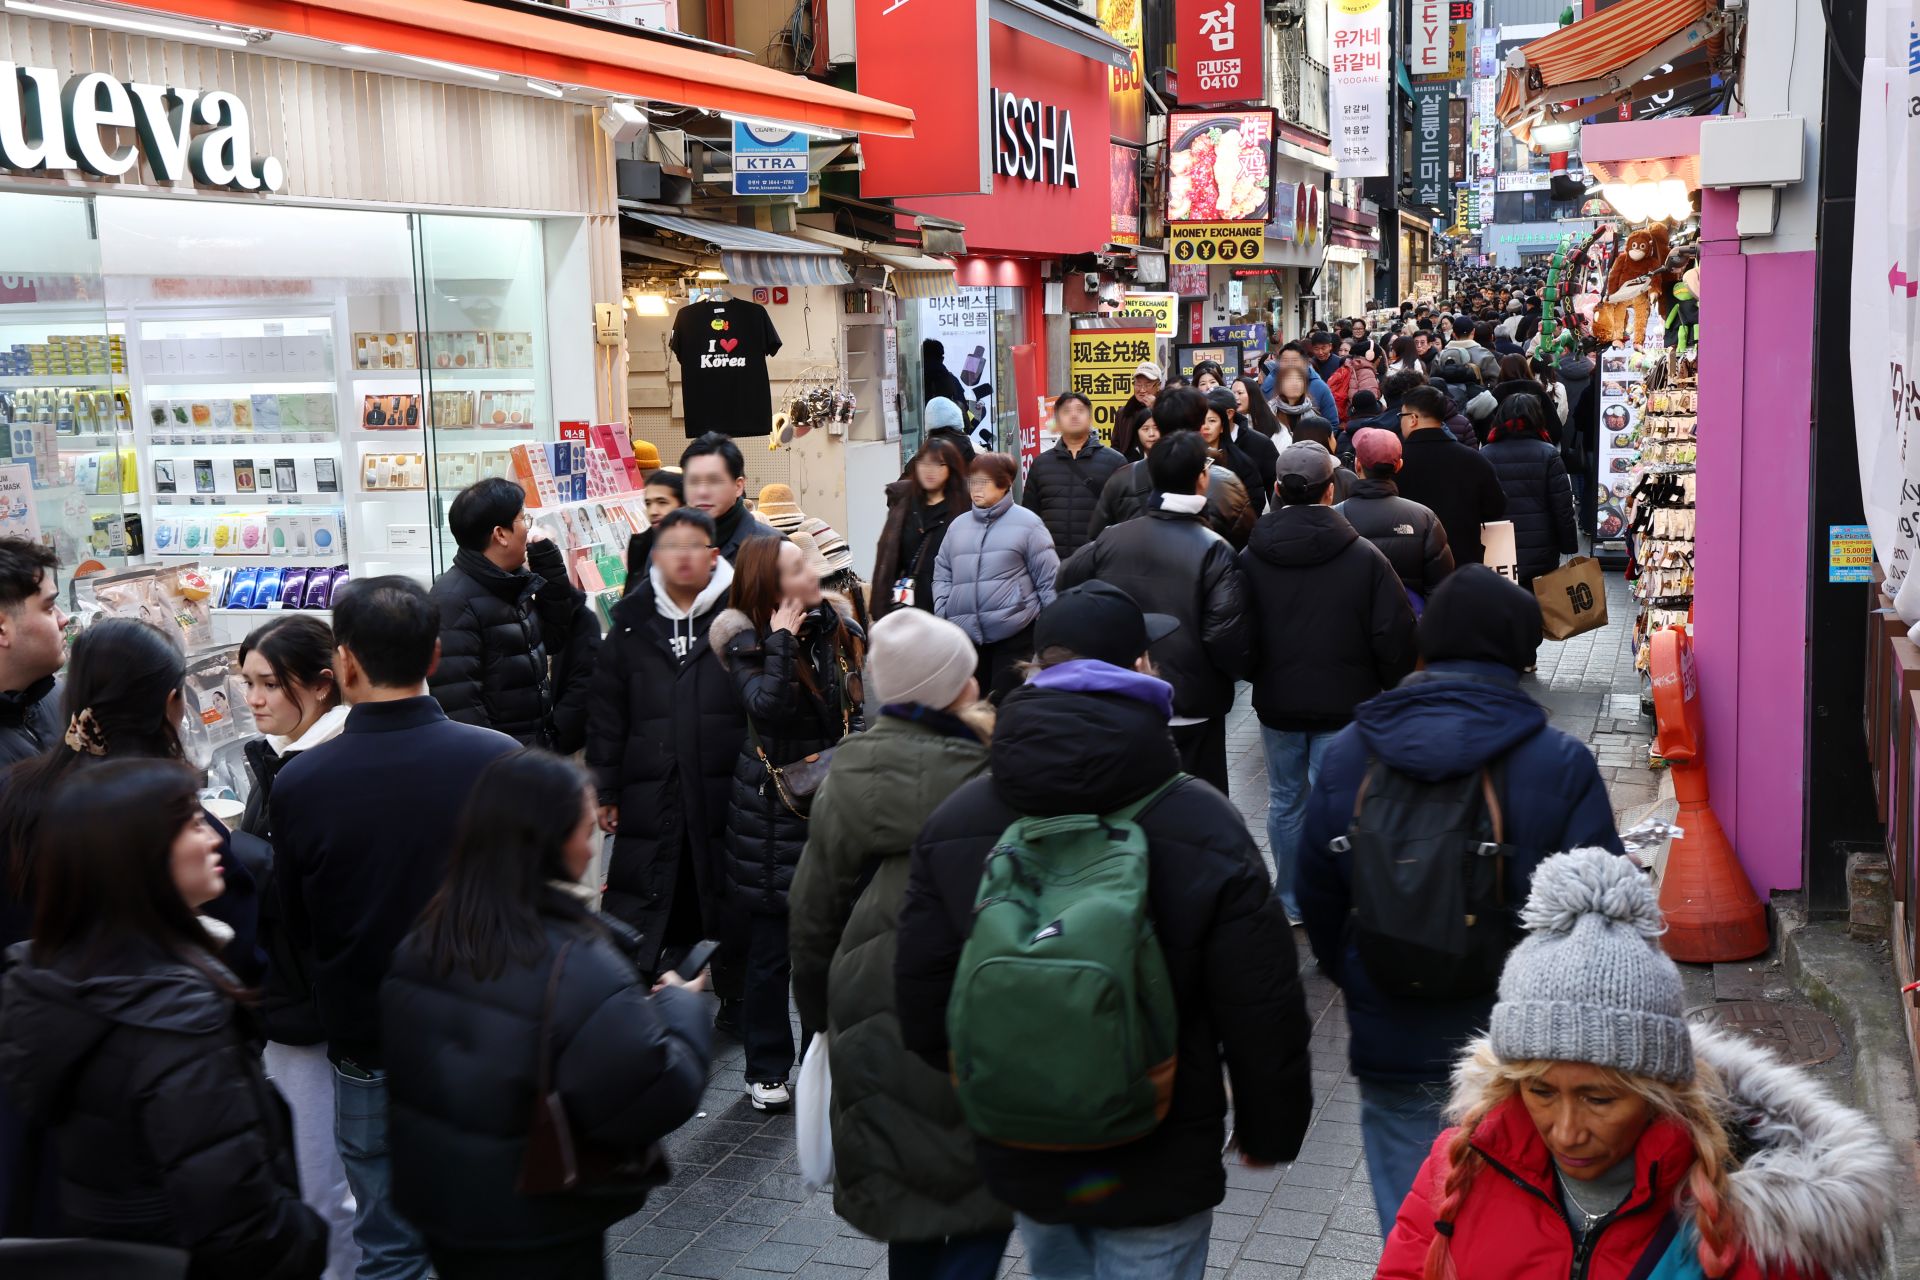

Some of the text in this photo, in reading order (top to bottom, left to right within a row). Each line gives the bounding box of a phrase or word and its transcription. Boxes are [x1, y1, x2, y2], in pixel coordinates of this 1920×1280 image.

[1199, 1, 1235, 52] 점
[1333, 27, 1380, 48] 유가네
[1199, 61, 1240, 75] PLUS+
[1333, 52, 1380, 72] 닭갈비
[1200, 75, 1239, 90] 0410
[1338, 75, 1380, 84] YOOGANE
[1344, 104, 1369, 114] 닭갈비
[1344, 125, 1370, 135] 볶음밥
[1237, 116, 1268, 180] 炸鸡
[1344, 147, 1369, 155] 막국수
[747, 158, 796, 169] KTRA
[1460, 194, 1468, 228] MART
[1173, 227, 1262, 238] MONEY EXCHANGE
[929, 296, 999, 310] 미샤 베스트
[938, 312, 988, 327] 5대 앰플
[1229, 330, 1247, 339] ACE
[709, 340, 716, 352] I
[1073, 340, 1151, 363] 现金兑换
[701, 354, 746, 369] Korea
[1073, 373, 1136, 394] 現金両
[1566, 582, 1594, 615] 10
